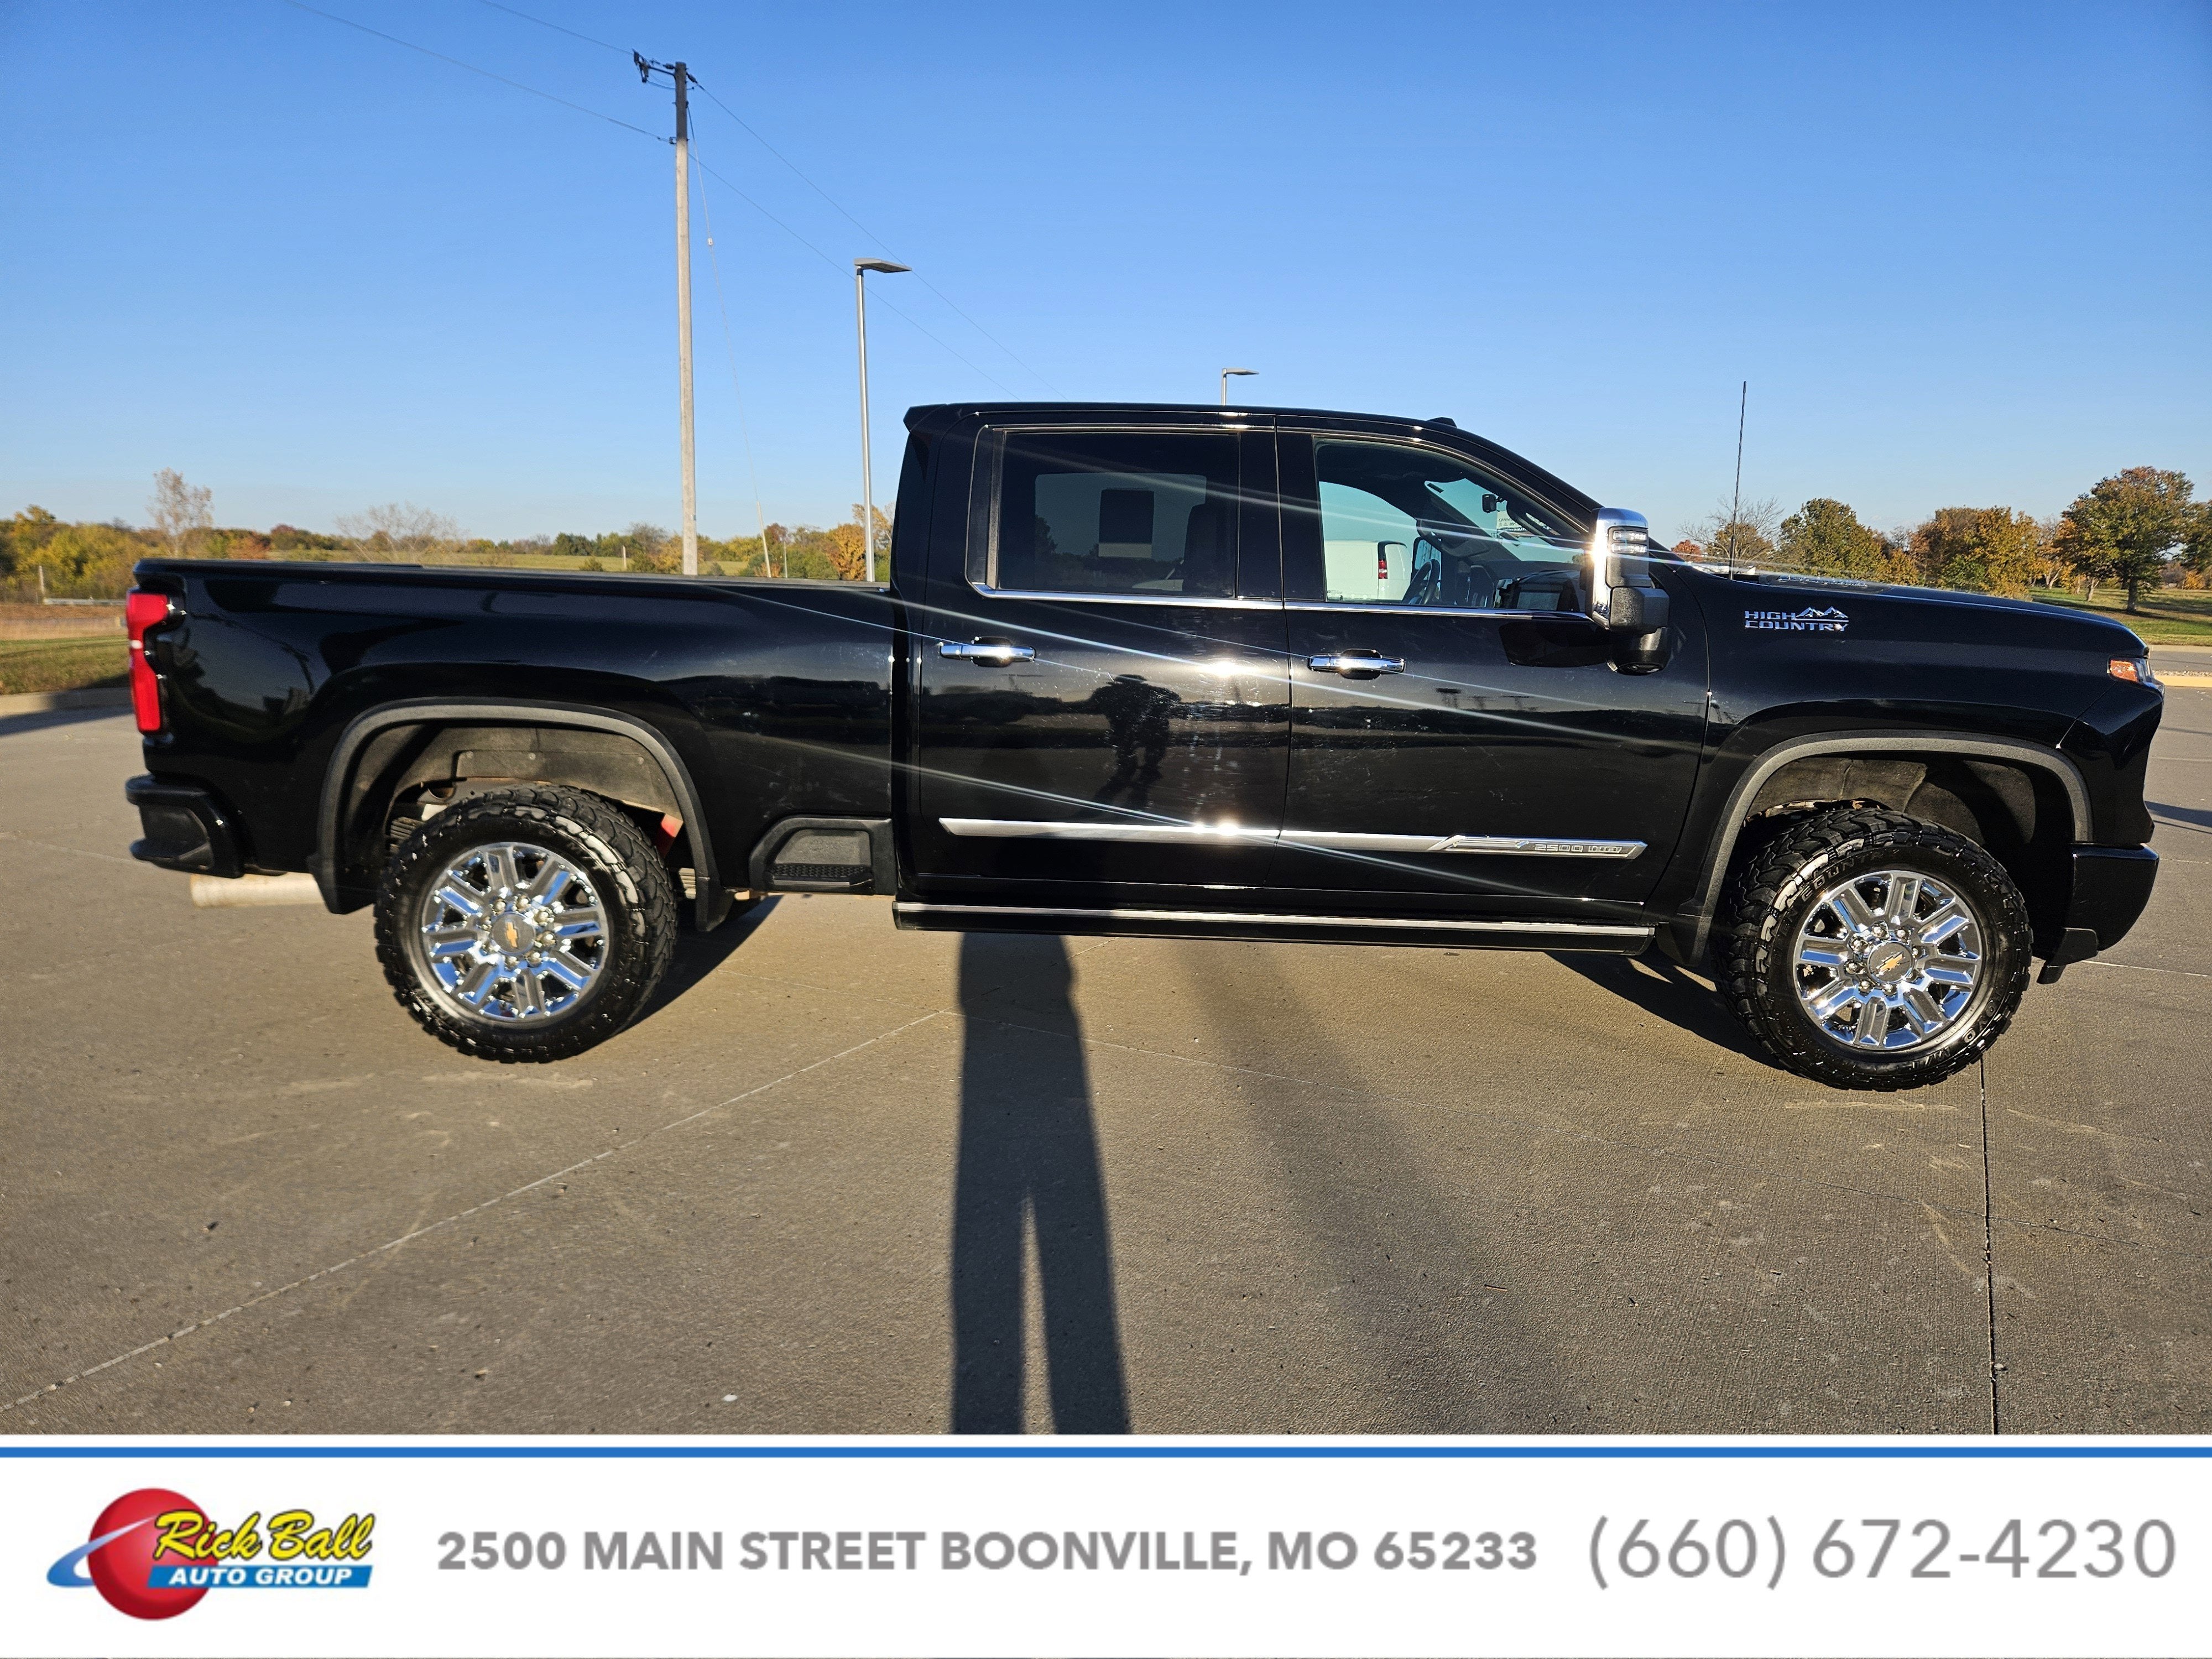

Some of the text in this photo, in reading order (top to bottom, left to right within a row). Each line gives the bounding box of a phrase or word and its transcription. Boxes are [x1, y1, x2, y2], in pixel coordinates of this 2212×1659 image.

[1745, 611, 1796, 620] HIGH
[1745, 620, 1848, 632] COUNTRY
[1534, 843, 1584, 853] 2500
